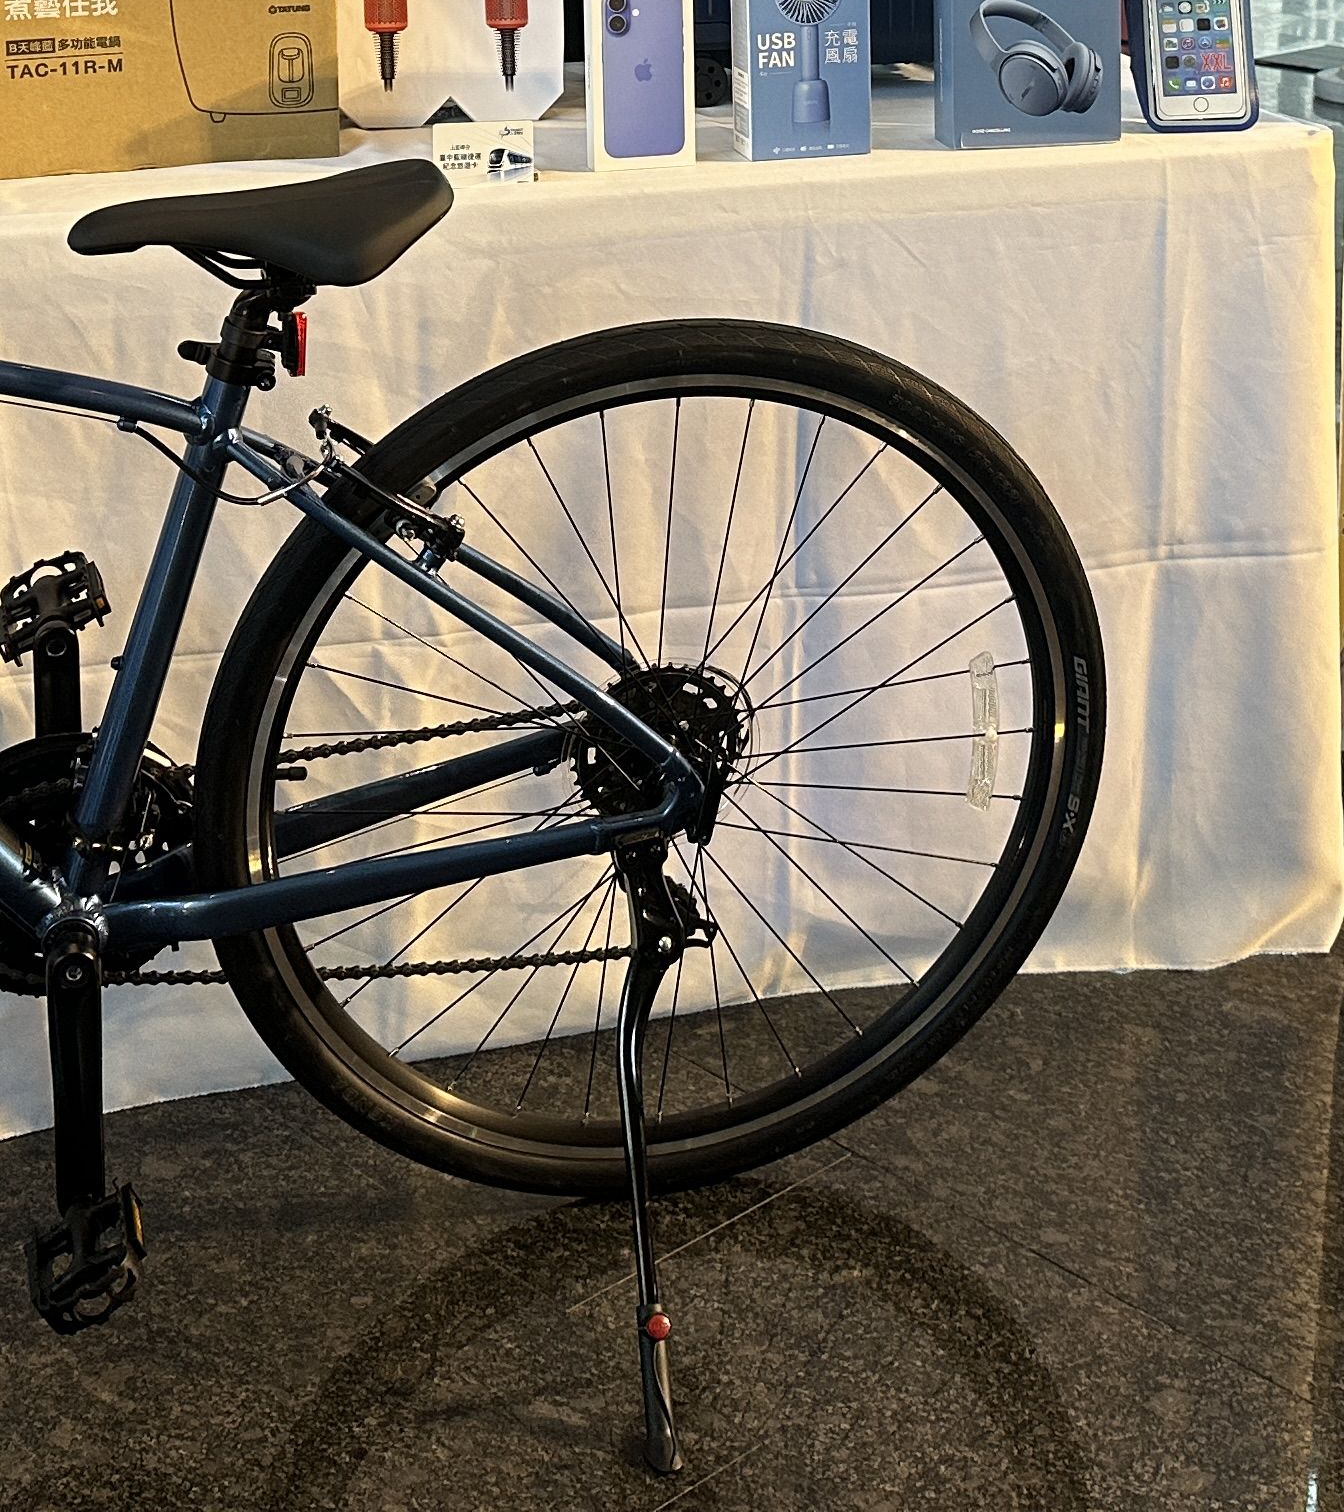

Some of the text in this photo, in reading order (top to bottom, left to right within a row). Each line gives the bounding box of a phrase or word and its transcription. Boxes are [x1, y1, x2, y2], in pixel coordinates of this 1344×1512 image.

[277, 4, 310, 13] TATUNG
[757, 32, 796, 51] USB
[6, 58, 123, 80] TAC-11R-M
[758, 51, 795, 69] FAN
[1200, 52, 1232, 72] XXL
[1073, 655, 1090, 734] GIANT
